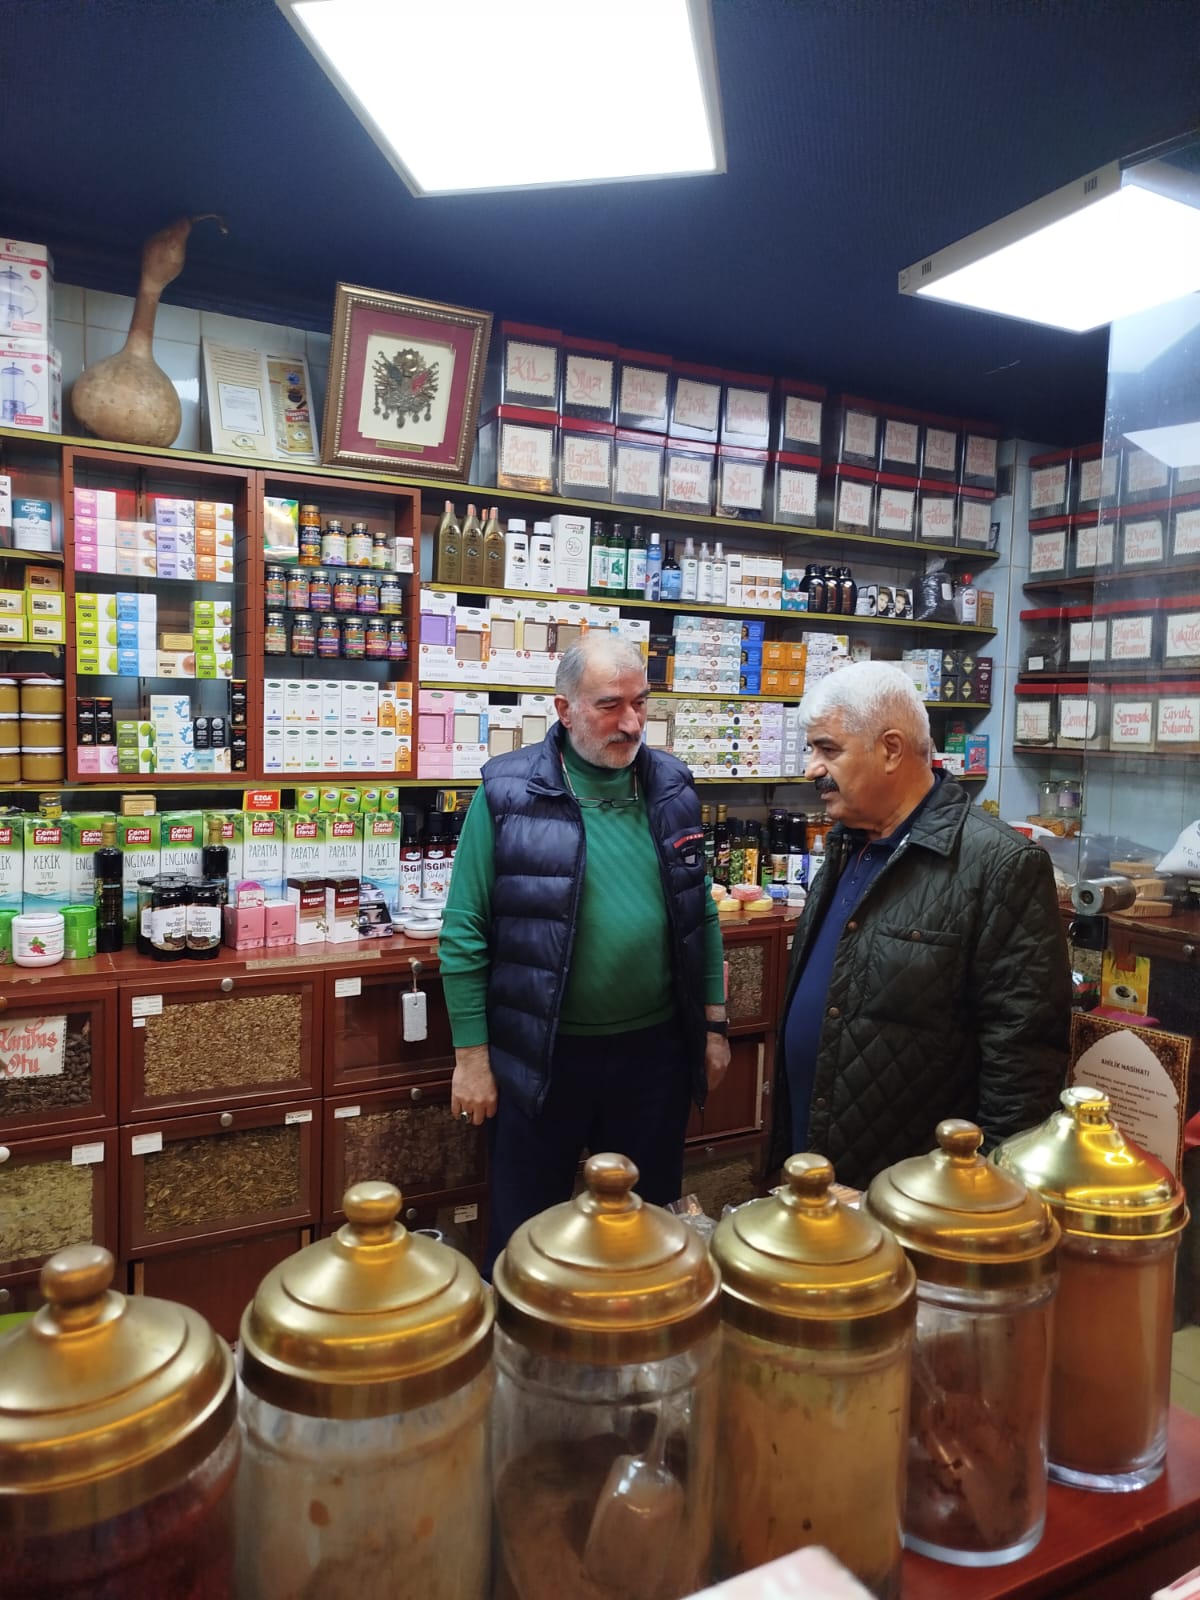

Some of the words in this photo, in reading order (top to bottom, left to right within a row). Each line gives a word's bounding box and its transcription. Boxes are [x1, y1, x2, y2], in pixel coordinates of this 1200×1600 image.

[248, 844, 278, 857] PAPATYA
[290, 846, 320, 860] PAPATYA
[328, 844, 357, 858] PAPATYA
[33, 852, 60, 870] KEKİK
